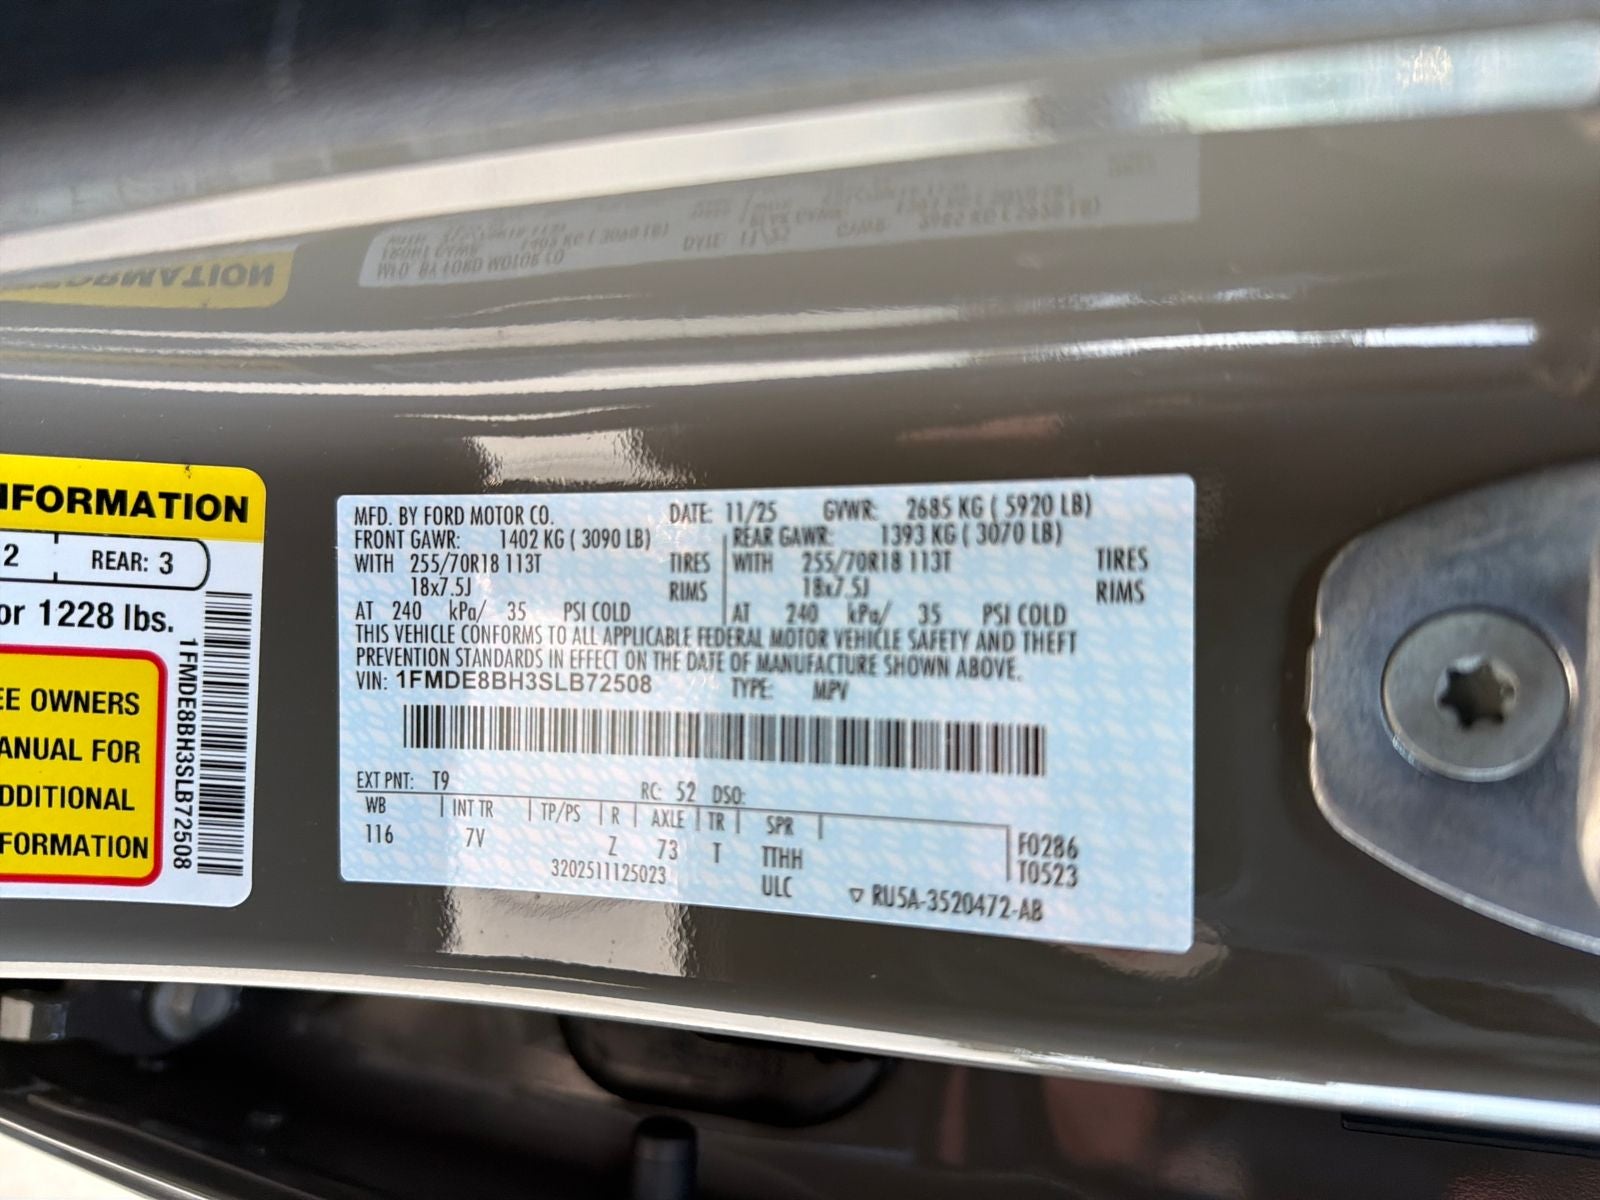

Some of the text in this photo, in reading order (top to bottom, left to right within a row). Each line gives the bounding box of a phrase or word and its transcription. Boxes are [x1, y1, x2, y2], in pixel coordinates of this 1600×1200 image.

[354, 504, 555, 527] MFD. BY FORD MOTOR CO.
[668, 500, 778, 525] DATE: 11/25
[822, 498, 879, 522] GVWR:
[905, 495, 953, 521] 2685
[957, 495, 984, 519] KG
[1005, 493, 1055, 518] 5920
[1060, 492, 1092, 519] LB)
[354, 528, 408, 550] FRONT
[410, 528, 461, 550] GAWR:
[500, 528, 539, 549] 1402
[543, 528, 565, 549] KG
[581, 528, 622, 549] 3090
[626, 527, 652, 551] LB)
[732, 526, 773, 547] REAR
[778, 525, 835, 546] GAWR:
[880, 523, 927, 545] 1393
[931, 522, 957, 544] KG
[975, 521, 1026, 544] 3070
[1031, 520, 1063, 546] LB)
[3, 542, 20, 567] 2
[91, 549, 174, 575] REAR: 3
[354, 552, 543, 575] WITH 255/70R18 113T
[668, 551, 712, 573] TIRES
[732, 549, 953, 573] WITH 255/70R18 113T
[1096, 546, 1149, 572] TIRES
[411, 576, 472, 598] 18x7.5J
[668, 580, 709, 601] RIMS
[802, 576, 870, 599] 18x7.5J
[1095, 579, 1147, 603] RIMS
[0, 598, 174, 633] or 1228 lbs.
[354, 599, 632, 623] AT 240 kPa/ 35 PSI COLD
[731, 601, 1067, 627] AT 240 kPa/ 35 PSI COLD
[355, 623, 1078, 655] THIS VEHICLE CONFORMS TO ALL APPLICABLE FEDERAL MOTOR VEHICLE SAFETY AND THEFT
[355, 647, 1023, 682] PREVENTION STANDARDS IN EFFECT ON THE DATE OF MANUFACTURE SHOWN ABOVE.
[356, 670, 653, 694] VIN: 1FMDE8BH3SLB72508
[731, 678, 850, 702] TYPE: MPV
[0, 686, 141, 716] E OWNERS
[91, 738, 141, 764] FOR
[172, 638, 199, 870] 1FMDE8BH3SLB72508
[356, 770, 451, 791] EXT PNT: T9
[641, 780, 697, 802] RC: 52
[0, 783, 136, 811] DDITIONAL
[365, 796, 387, 814] WB
[712, 784, 747, 806] DSO:
[452, 797, 495, 819] INT TR
[540, 802, 582, 824] TP/PS
[611, 805, 620, 825] R
[650, 807, 685, 830] AXLE
[708, 810, 726, 832] TR
[765, 814, 795, 837] SPR
[0, 831, 149, 859] FORMATION
[365, 823, 395, 845] 116
[465, 827, 486, 848] 7V
[608, 835, 619, 857] Z
[1017, 831, 1080, 861] F0286
[656, 838, 679, 861] 73
[712, 841, 722, 864] T
[761, 844, 804, 871] TTHH
[550, 858, 667, 886] 3202511125023
[1016, 859, 1080, 889] T0523
[761, 874, 793, 899] ULC
[871, 883, 1044, 922] RU5A-3520472-AB
